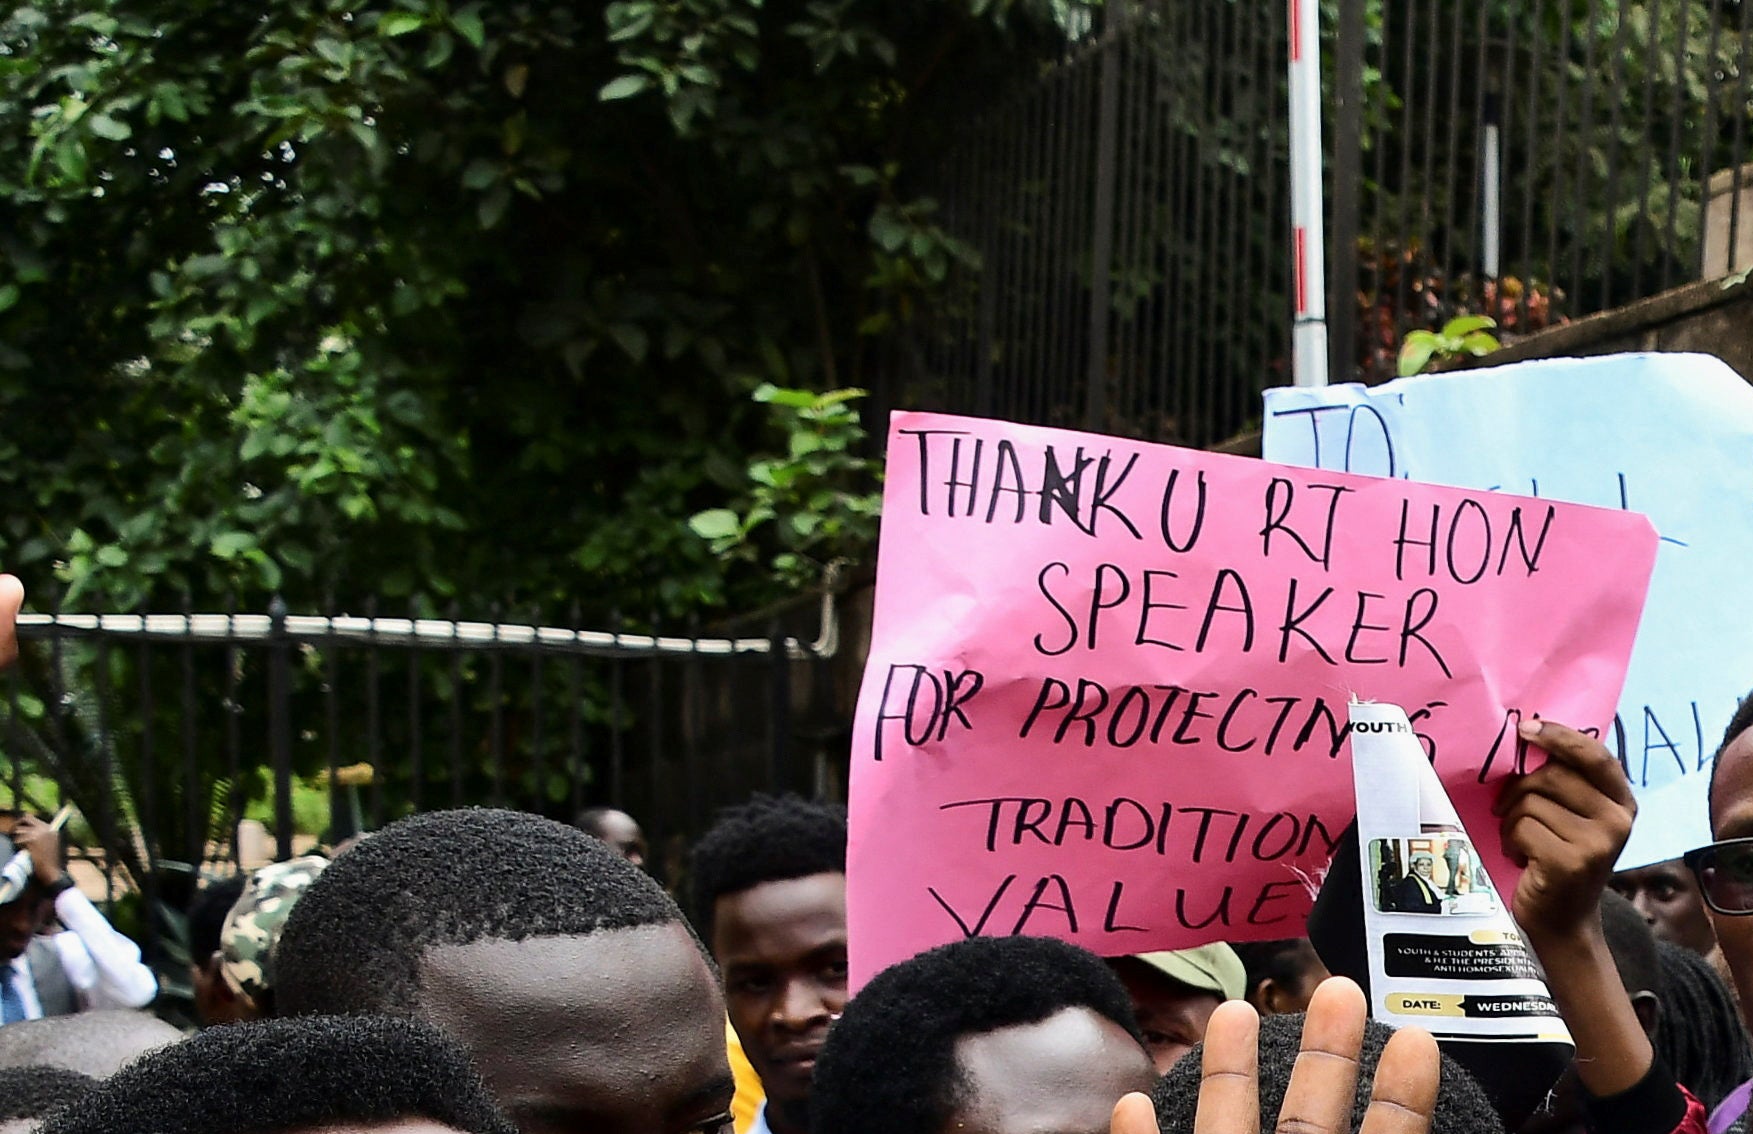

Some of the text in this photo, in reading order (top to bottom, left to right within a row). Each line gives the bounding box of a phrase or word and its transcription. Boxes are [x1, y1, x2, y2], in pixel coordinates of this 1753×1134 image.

[898, 429, 1143, 540] THANK
[1160, 469, 1207, 553] U
[1259, 478, 1356, 571] RT
[1393, 498, 1556, 585] HON
[1033, 560, 1453, 679] SPEAKER
[874, 662, 984, 761] FOR
[1349, 721, 1408, 734] YOUTH
[928, 873, 1308, 938] VALUE
[1402, 999, 1441, 1010] DATE:
